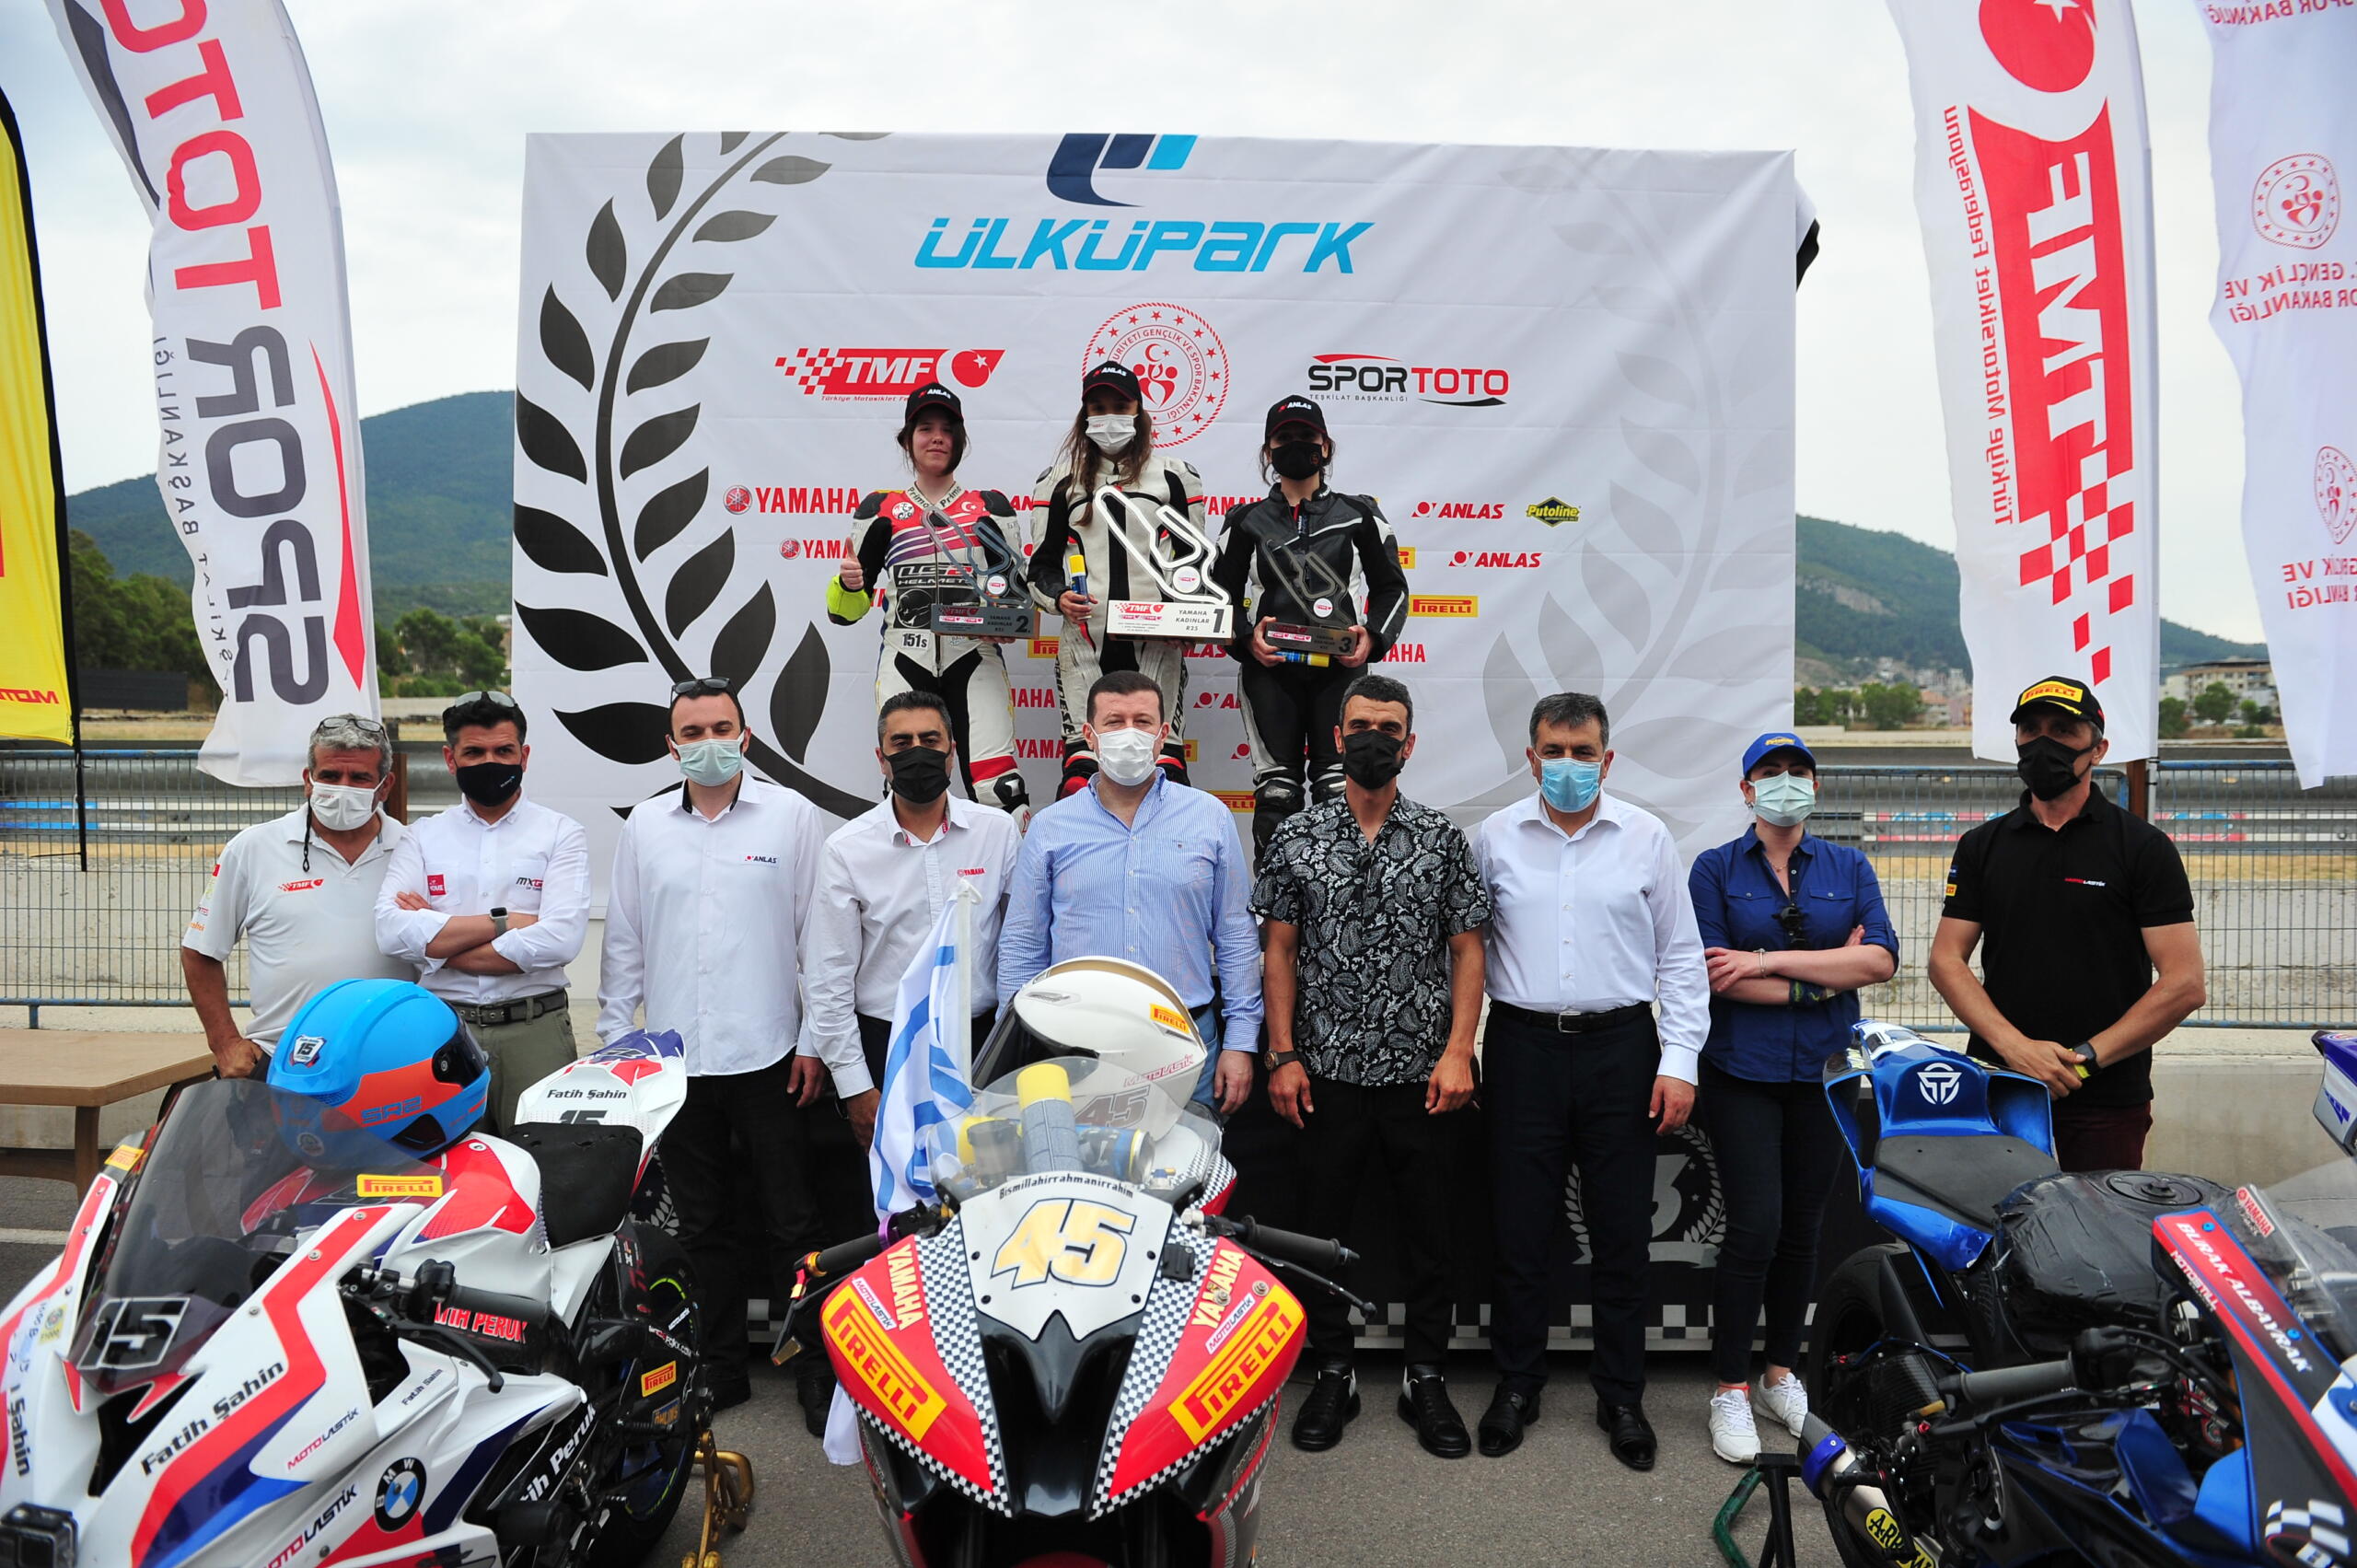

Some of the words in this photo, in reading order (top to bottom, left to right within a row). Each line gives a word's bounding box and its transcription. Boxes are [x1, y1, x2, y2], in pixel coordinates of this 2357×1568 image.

[844, 356, 935, 384] TMF
[755, 487, 860, 514] YAMAHA
[1438, 503, 1506, 519] ANLAS
[1527, 504, 1580, 518] Putoline
[1474, 552, 1543, 568] ANLAS
[1413, 599, 1471, 614] PIRELLI
[753, 855, 778, 864] ANLAS
[290, 881, 311, 890] TMF
[1154, 1007, 1187, 1032] PIRELLI
[296, 1041, 317, 1055] 15
[547, 1089, 584, 1098] Fatih
[586, 1089, 627, 1100] Şahin
[364, 1179, 434, 1193] PIRELLI
[999, 1173, 1133, 1200] Bismillahirrahmanirrahim
[2243, 1195, 2274, 1238] YAMAHA
[990, 1198, 1138, 1290] 45
[888, 1244, 923, 1330] YAMAHA
[2175, 1223, 2231, 1284] BURAK
[2229, 1277, 2312, 1373] ALBAYRAK
[830, 1297, 929, 1422] PIRELLI
[1182, 1301, 1293, 1428] PIRELLI
[644, 1365, 674, 1391] PIRELLI
[140, 1417, 209, 1477] Fatih
[213, 1363, 284, 1422] Şahin
[551, 1403, 597, 1474] Peruk
